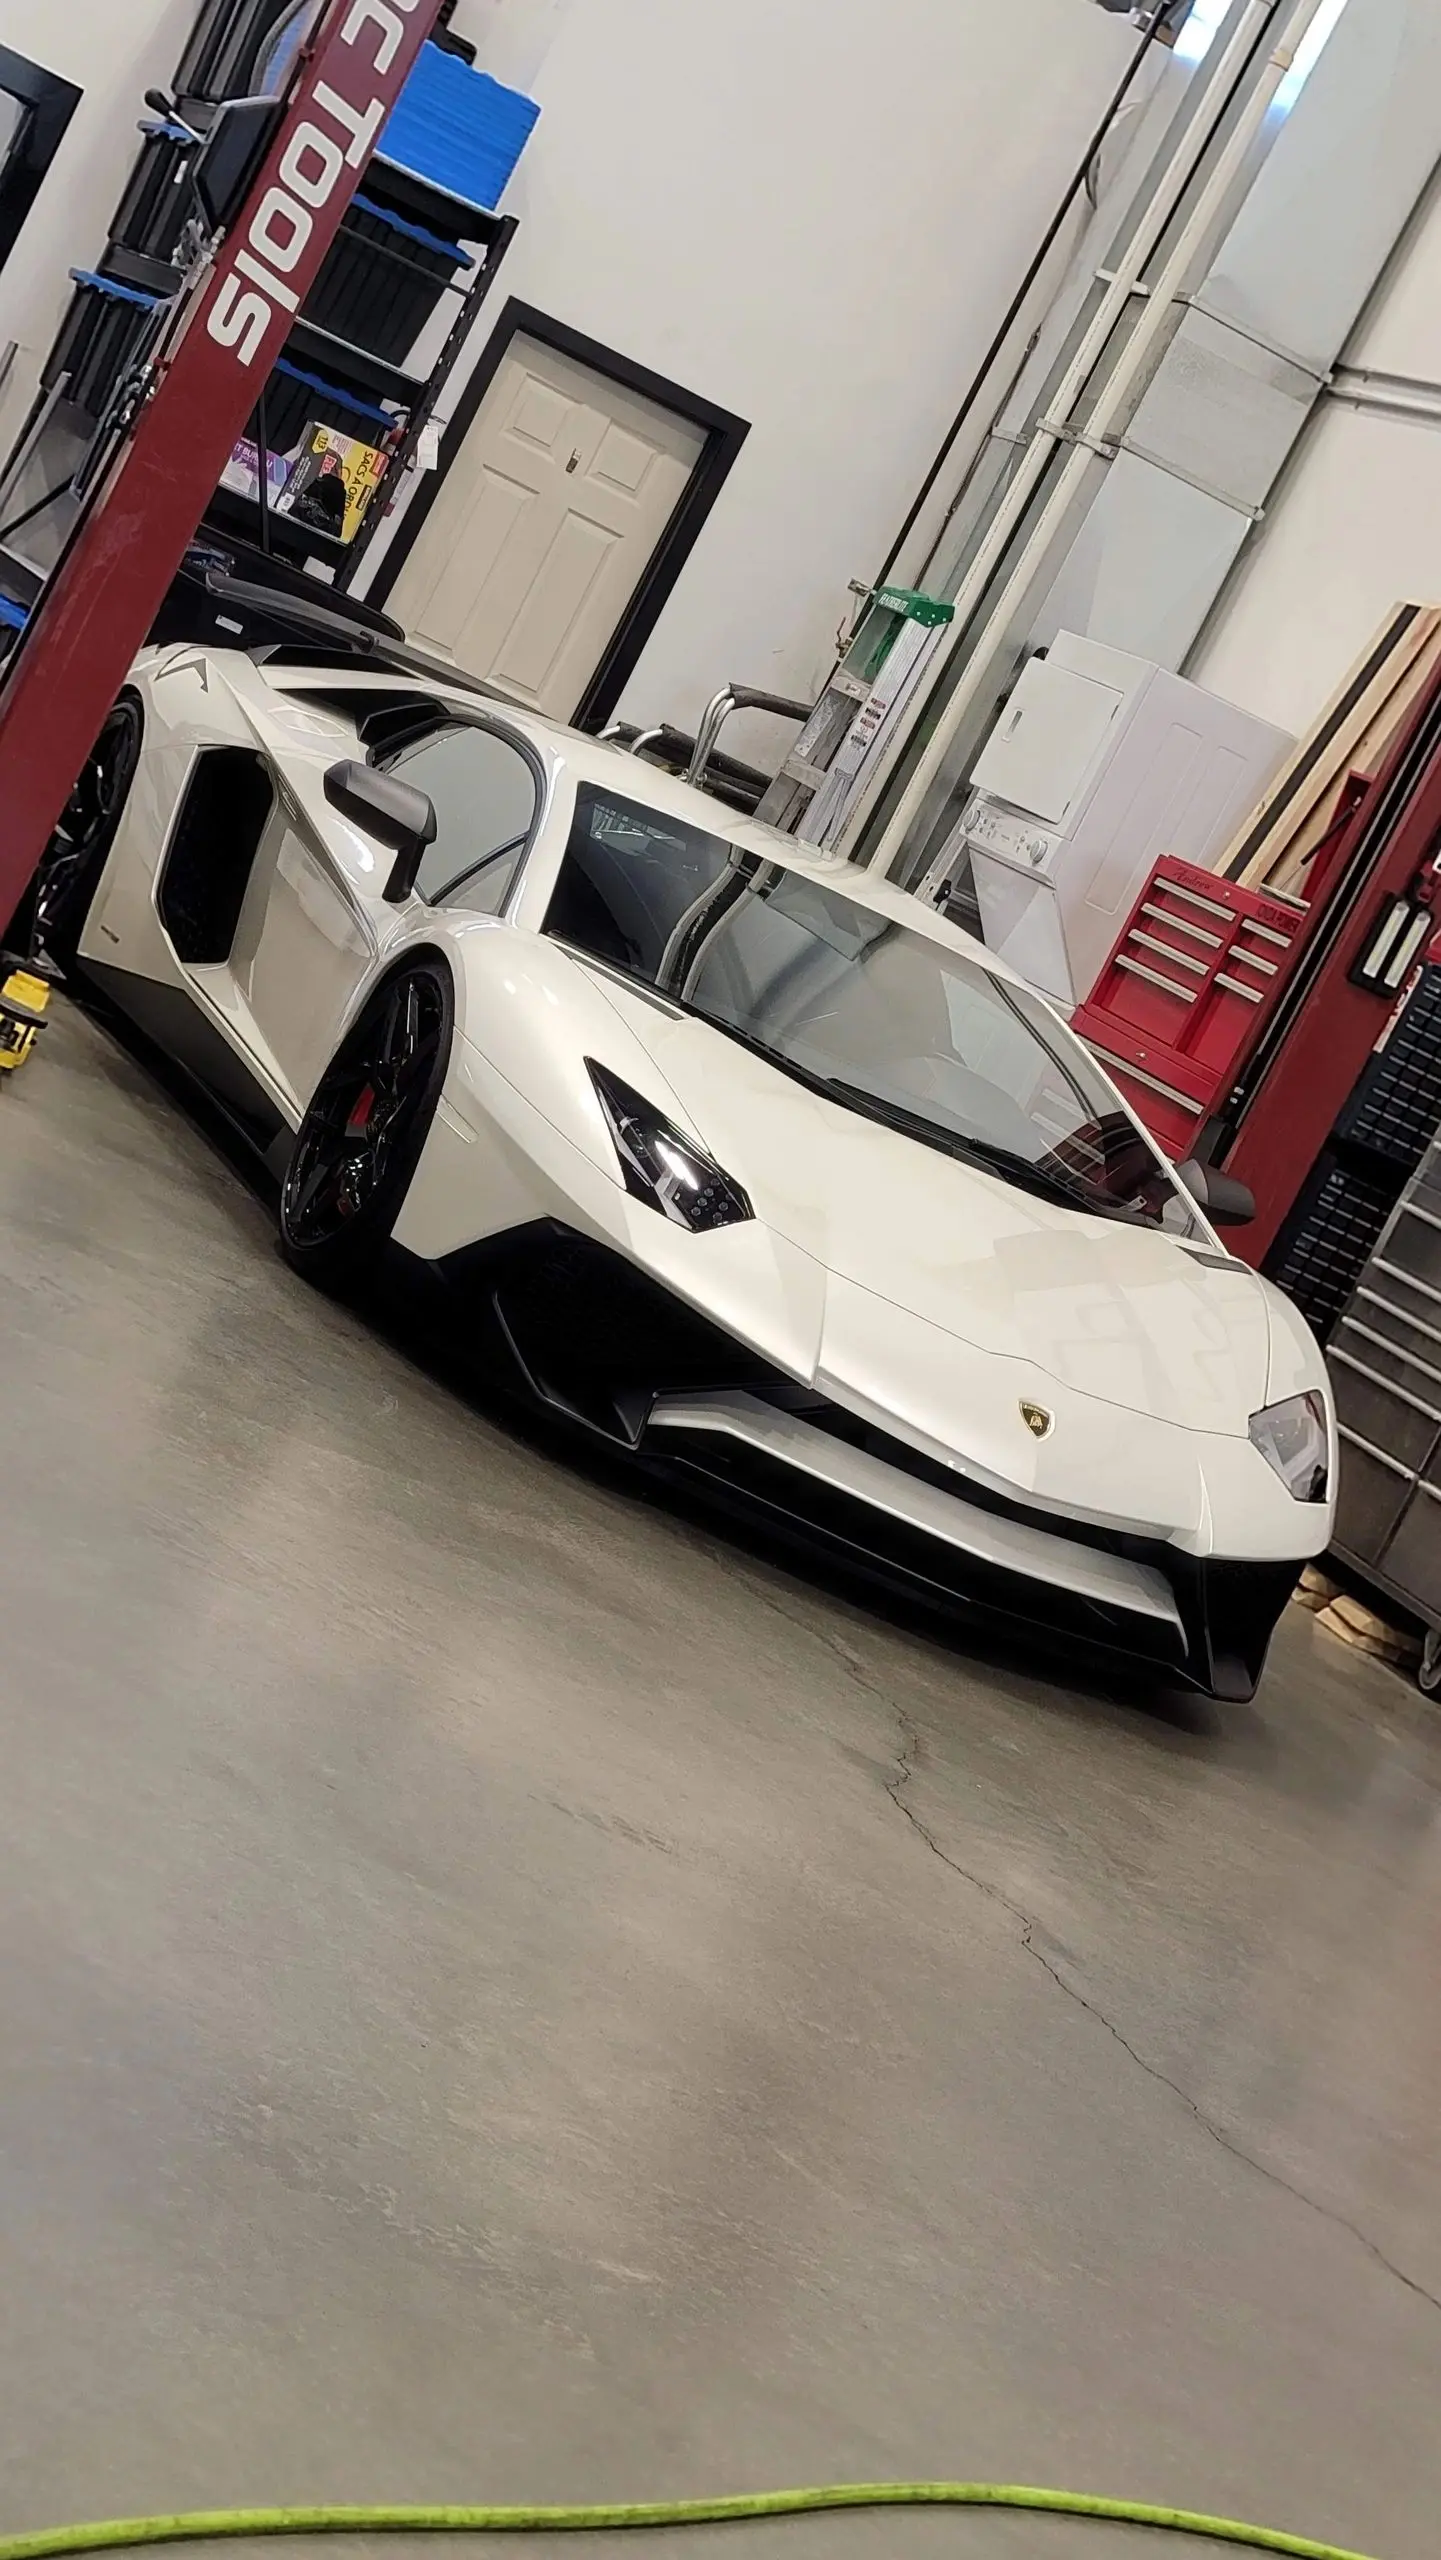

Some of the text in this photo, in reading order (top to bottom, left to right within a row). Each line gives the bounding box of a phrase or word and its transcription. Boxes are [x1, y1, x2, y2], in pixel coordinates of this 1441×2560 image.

[341, 0, 420, 75] c
[242, 447, 272, 468] BURU
[357, 451, 373, 477] SACS
